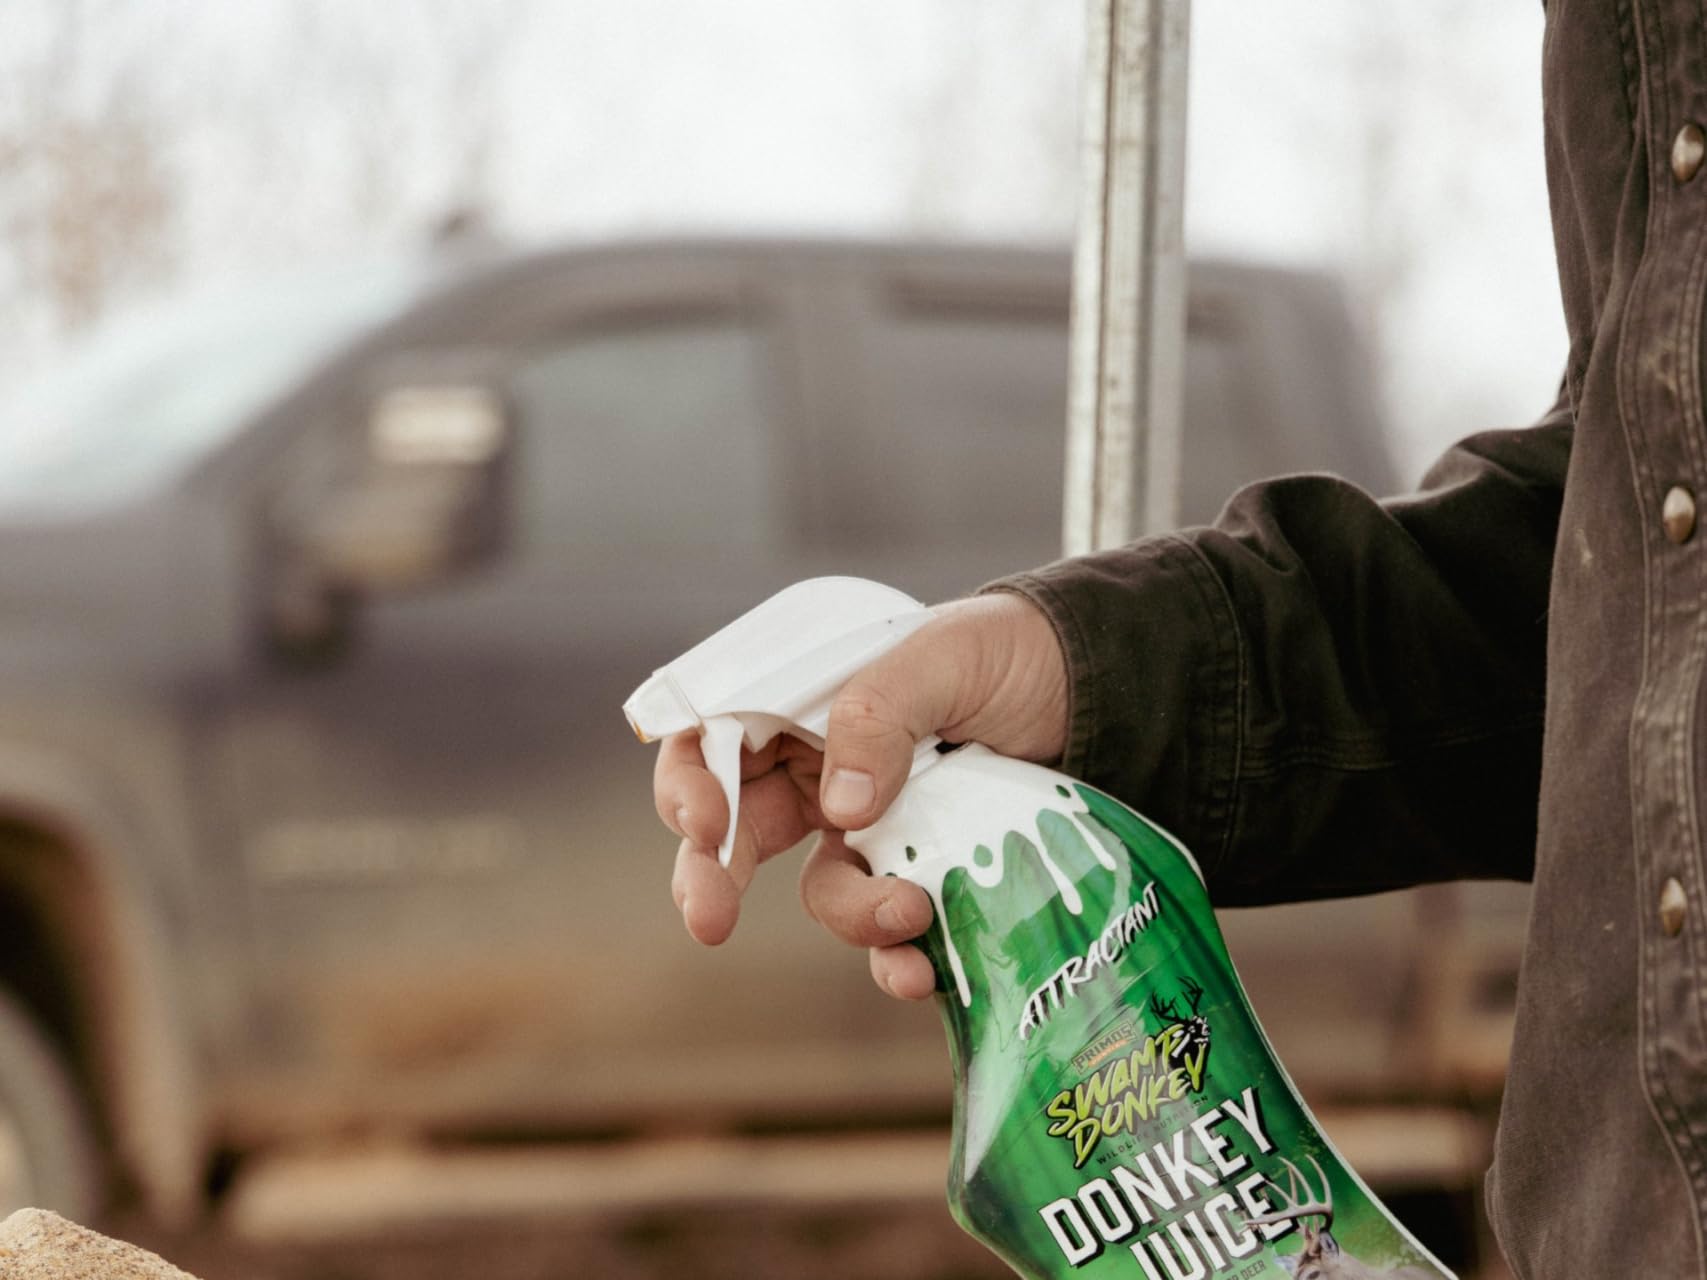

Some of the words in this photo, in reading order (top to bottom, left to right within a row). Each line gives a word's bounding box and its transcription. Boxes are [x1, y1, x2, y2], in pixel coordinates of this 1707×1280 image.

[1018, 879, 1161, 1041] ATTRACTANT
[1046, 1022, 1187, 1137] SWAMP
[1066, 1042, 1208, 1169] DONKEY
[1074, 1025, 1134, 1070] PRIMOS
[1038, 1087, 1274, 1268] DONKEY
[1239, 1259, 1267, 1280] DEER
